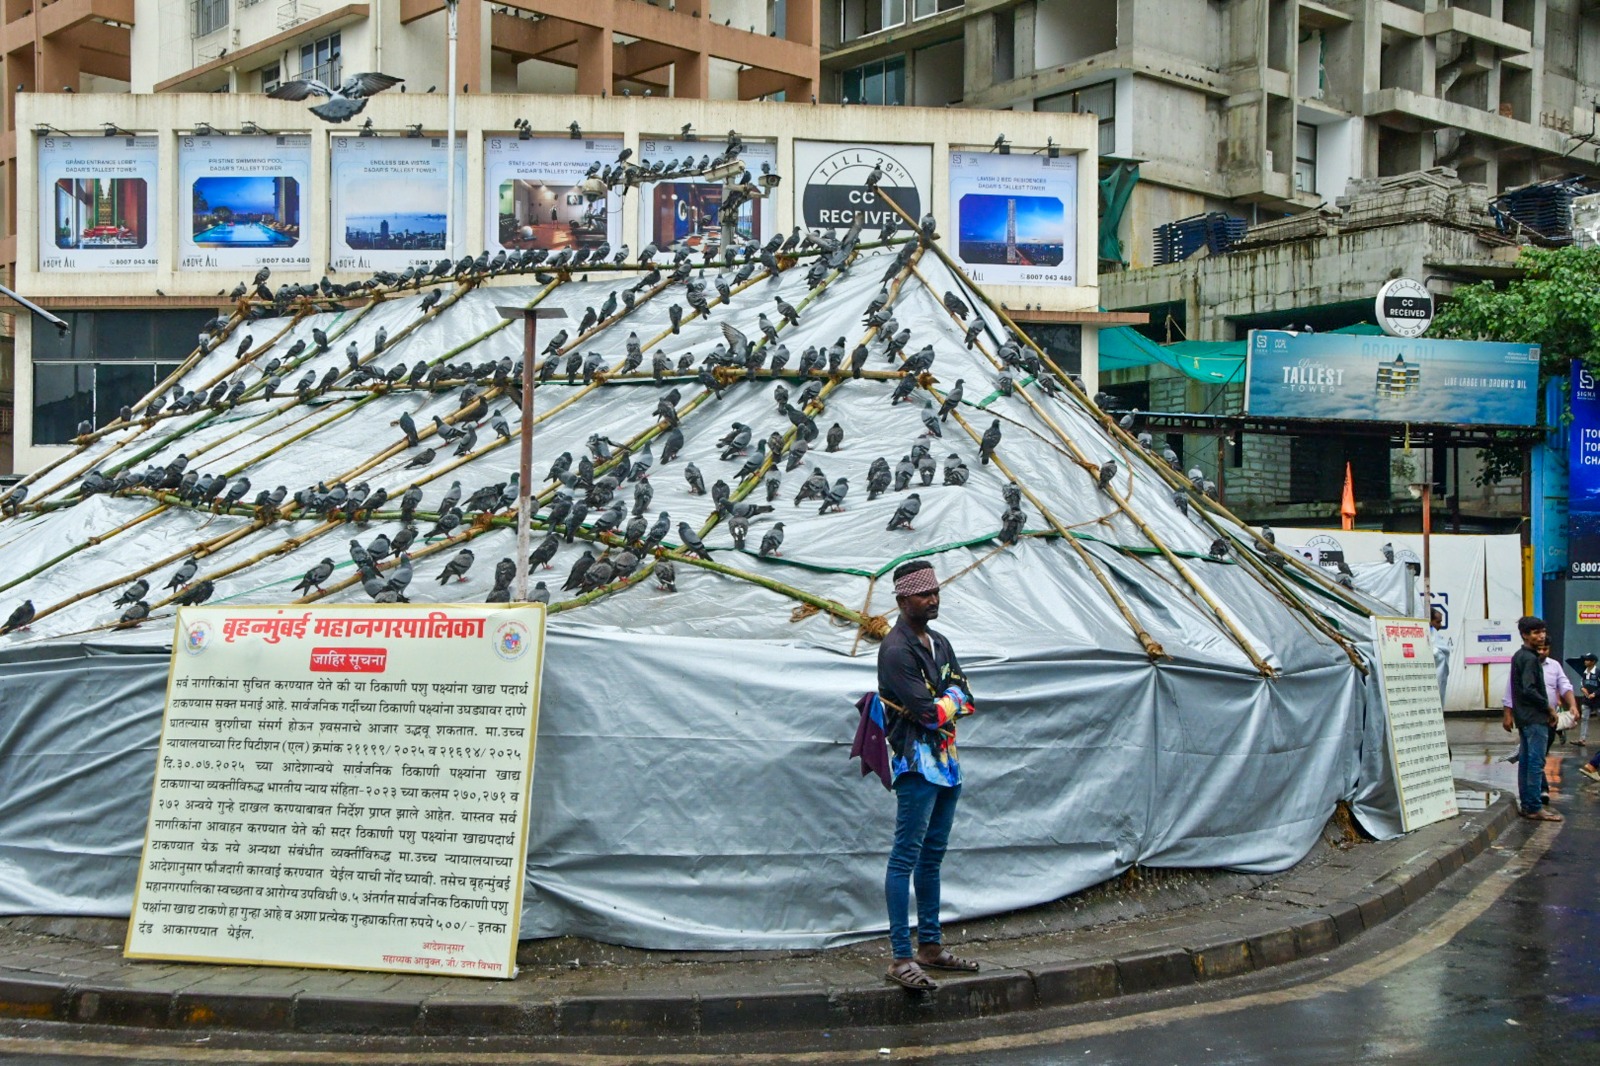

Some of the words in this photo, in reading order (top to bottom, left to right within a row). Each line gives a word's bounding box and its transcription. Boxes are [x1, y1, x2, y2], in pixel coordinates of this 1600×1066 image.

[820, 154, 862, 178] TILL
[848, 190, 875, 204] CC
[820, 209, 904, 225] RECIVED
[64, 256, 75, 268] ALL
[205, 254, 218, 267] ALL
[358, 256, 370, 268] ALL
[972, 269, 984, 281] ALL
[1390, 308, 1426, 317] RECEIVED
[1282, 366, 1344, 385] TALLEST
[1291, 385, 1335, 393] TOWER
[222, 610, 310, 643] बृहन्मुंबई
[315, 612, 485, 640] महानगरपालिका
[312, 652, 346, 667] जाहिर
[349, 654, 385, 671] सूचना
[175, 674, 188, 687] सर्व
[190, 675, 239, 688] नागरिकांना
[241, 676, 271, 693] सुचित
[273, 680, 314, 690] करण्यात
[316, 677, 333, 690] येते
[336, 677, 351, 691] की
[353, 681, 366, 691] या
[369, 678, 407, 692] ठिकाणी
[410, 682, 429, 696] पशु
[470, 684, 496, 694] खाद्य
[499, 681, 528, 696] पदार्थ
[172, 698, 213, 708] टाकण्यास
[214, 698, 238, 709] सक्त
[239, 696, 263, 712] मनाई
[265, 696, 286, 712] आहे.
[290, 697, 340, 711] सार्वजनिक
[378, 699, 416, 713] ठिकाणी
[504, 702, 526, 717] दाणे
[214, 715, 252, 733] बुरशीचा
[257, 716, 283, 730] संसर्ग
[287, 717, 314, 732] होऊन
[367, 723, 399, 733] आजार
[435, 724, 477, 736] शकतात.
[166, 738, 226, 748] न्यायालयाच्या
[226, 736, 242, 749] रिट
[243, 736, 280, 751] पिटीशन
[311, 739, 344, 754] क्रमांक
[394, 744, 424, 756] २०२५
[427, 745, 437, 755] व
[489, 747, 521, 760] २०२५
[158, 798, 179, 809] २७२
[184, 796, 213, 810] अन्वये
[216, 797, 235, 814] गुन्हे
[238, 801, 270, 813] दाखल
[273, 803, 333, 815] करण्याबाबत
[336, 802, 365, 817] निर्देश
[368, 807, 392, 819] प्राप्त
[395, 804, 419, 820] झाले
[460, 811, 495, 822] यास्तव
[498, 809, 517, 823] सर्व
[148, 857, 202, 875] आदेशानुसार
[203, 859, 244, 874] फौजदारी
[245, 862, 282, 878] कारवाई
[282, 866, 324, 878] करण्यात
[329, 865, 355, 882] येईल
[355, 867, 382, 881] याची
[383, 868, 402, 884] नोंद
[439, 871, 467, 886] तसेच
[468, 874, 511, 892] बृहन्मुंबई
[141, 899, 172, 912] पक्षांना
[172, 903, 196, 914] खाद्य
[197, 902, 228, 915] टाकणे
[228, 906, 239, 918] हा
[239, 906, 261, 921] गुन्हा
[262, 904, 283, 920] आहे
[283, 909, 293, 919] व
[294, 910, 318, 921] अशा
[318, 908, 349, 923] प्रत्येक
[409, 914, 434, 928] रुपये
[477, 921, 507, 934] इतका
[138, 920, 153, 934] दंड
[162, 924, 218, 936] आकारण्यात
[478, 959, 502, 971] विभाग
